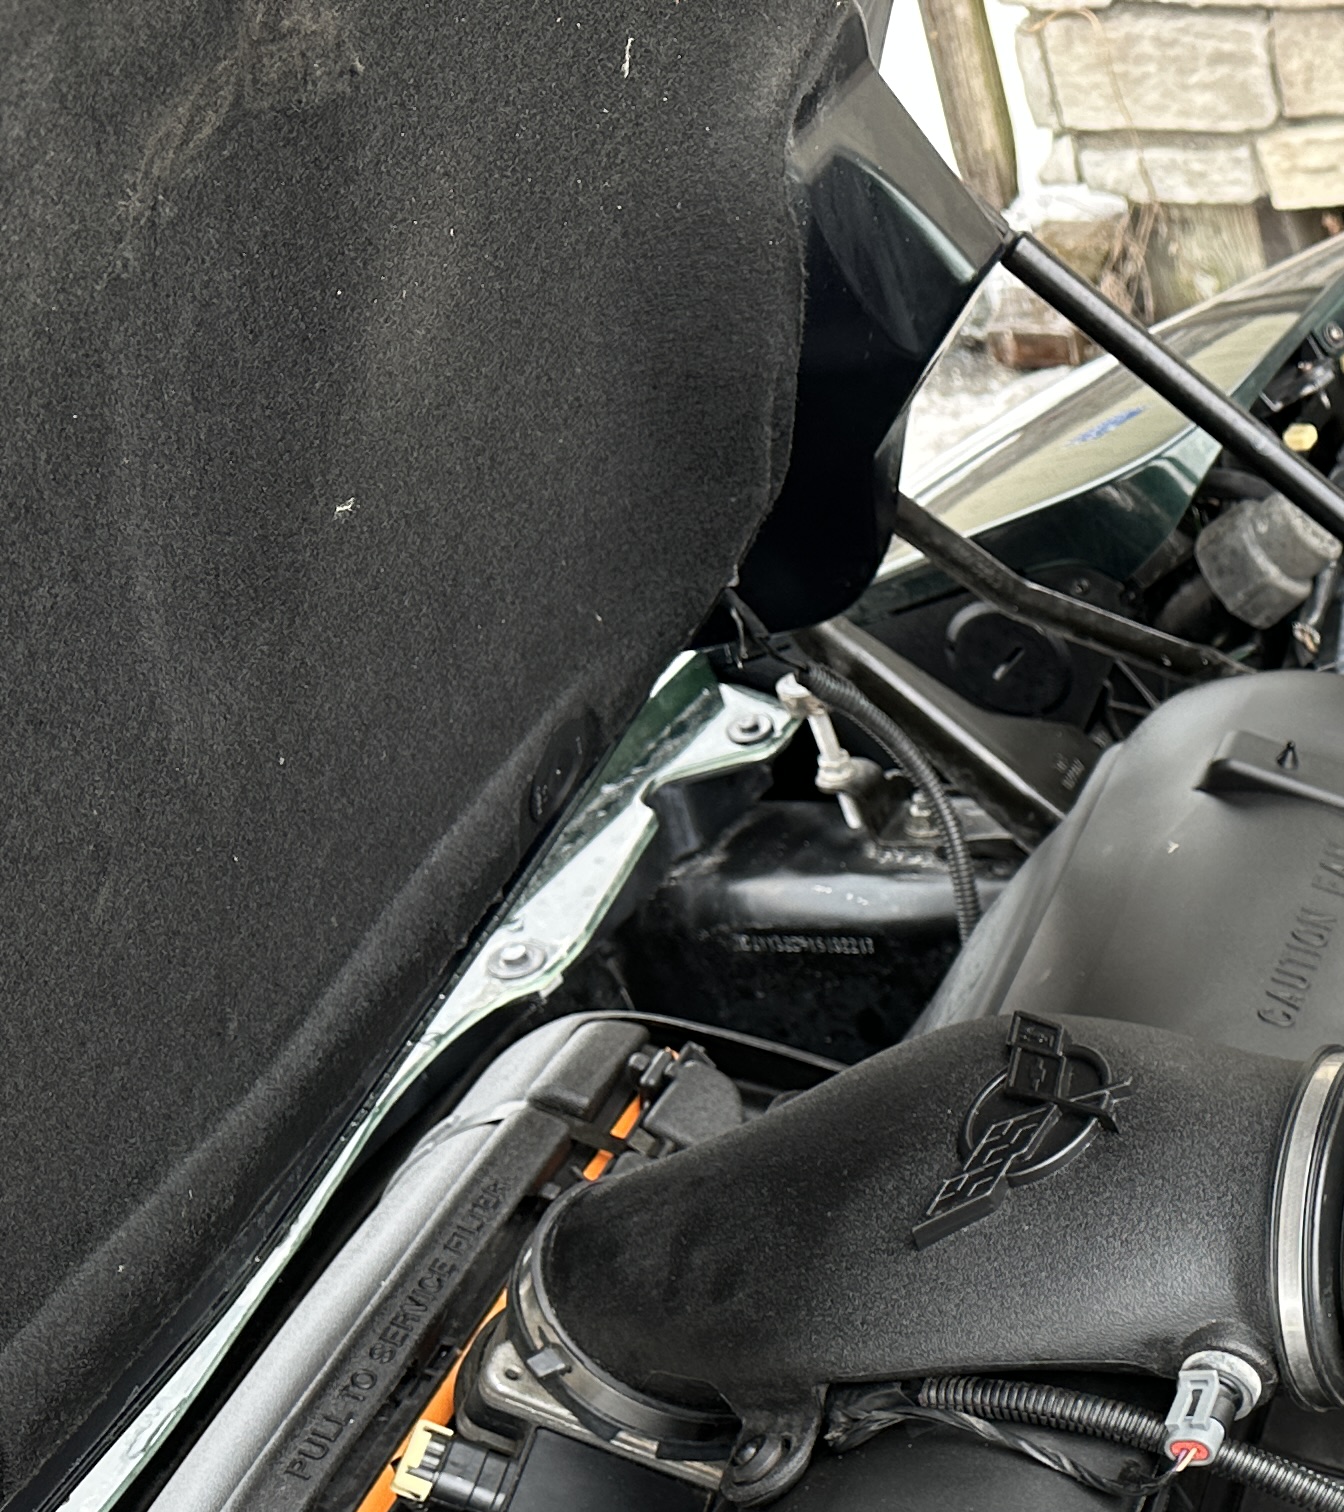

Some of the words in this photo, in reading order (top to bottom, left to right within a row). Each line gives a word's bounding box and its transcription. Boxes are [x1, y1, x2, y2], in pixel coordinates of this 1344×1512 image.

[1257, 906, 1337, 1028] CAUTION
[285, 1411, 347, 1481] PULL
[338, 1367, 378, 1401] TO
[368, 1256, 456, 1365] SERVICE
[442, 1180, 511, 1256] FILTER
